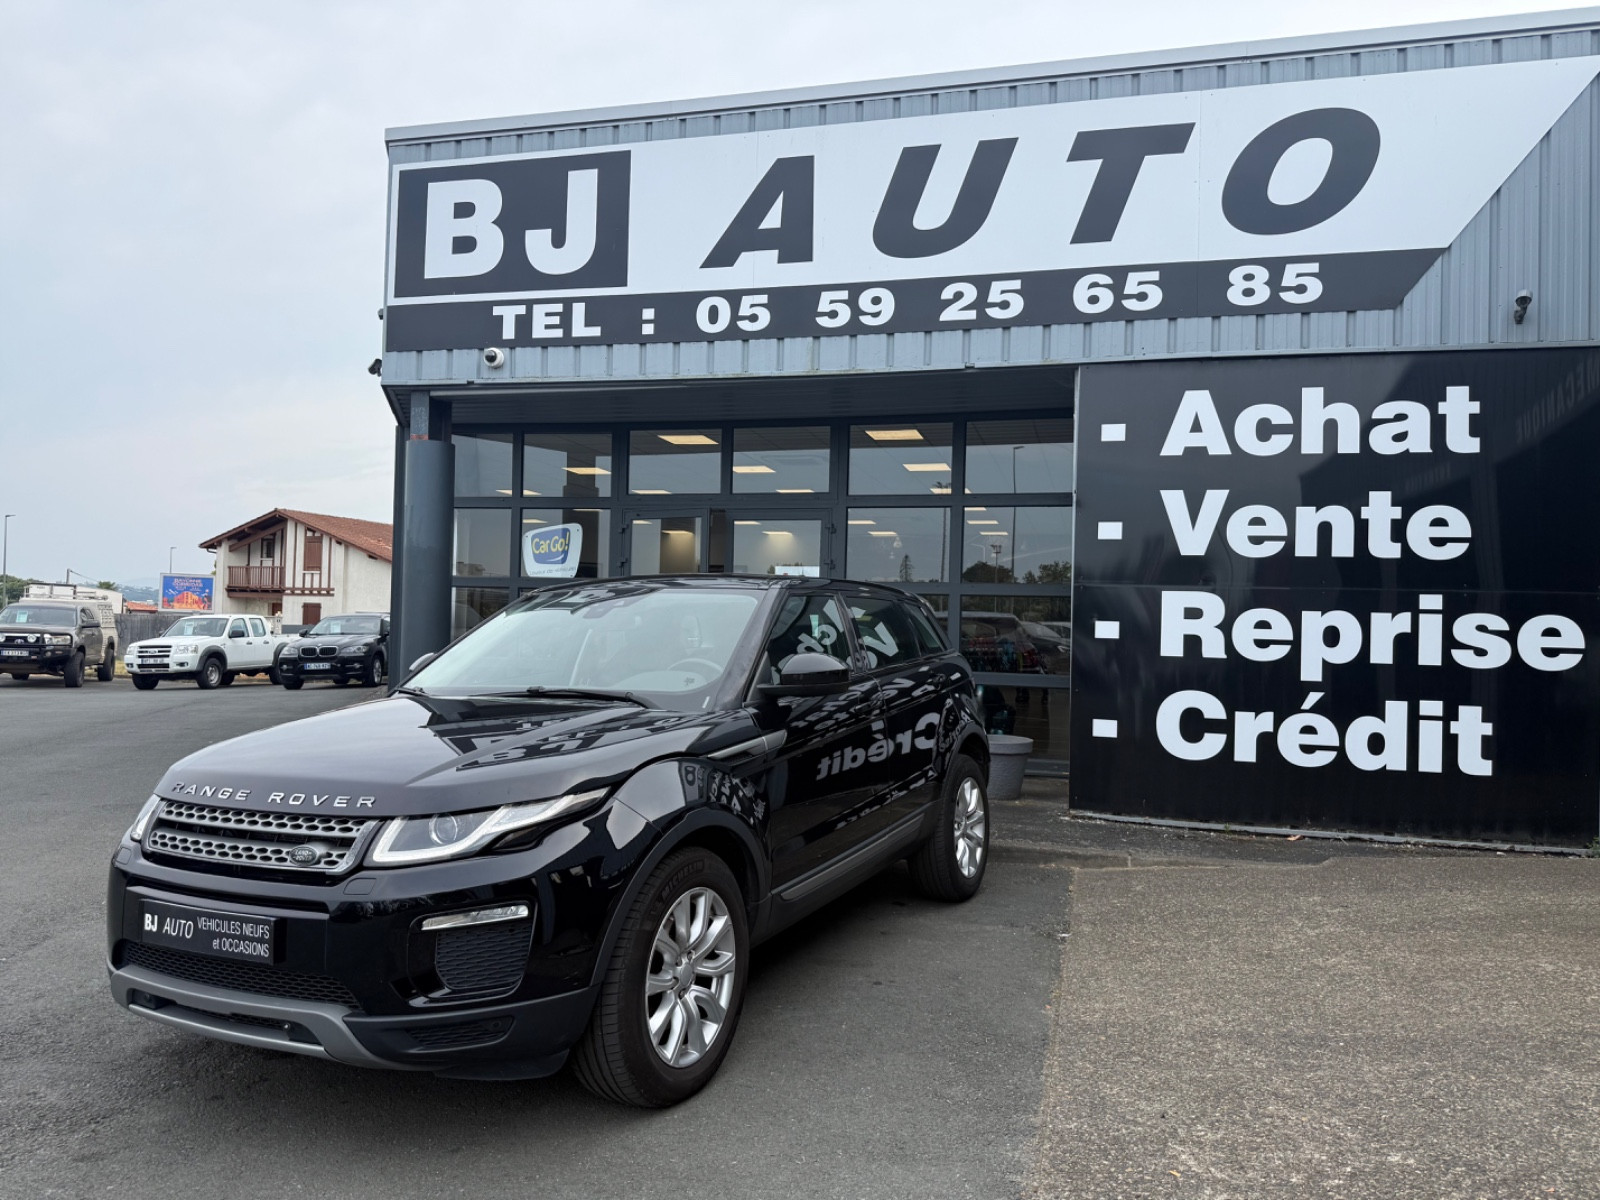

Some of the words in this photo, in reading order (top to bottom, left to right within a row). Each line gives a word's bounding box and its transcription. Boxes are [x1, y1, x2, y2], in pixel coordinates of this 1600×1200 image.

[424, 168, 598, 279] BJ
[700, 107, 1381, 268] AUTO
[492, 302, 601, 340] TEL
[696, 294, 771, 334] 05
[815, 287, 895, 328] 59
[939, 279, 1025, 322] 25
[1072, 270, 1163, 314] 65
[1226, 261, 1323, 306] 85
[1159, 385, 1481, 456] Achat
[1159, 489, 1472, 560] Vente
[1160, 590, 1586, 682] Reprise
[1155, 689, 1493, 776] Crédit
[171, 781, 251, 801] RANGE
[267, 792, 376, 808] ROVER
[144, 913, 158, 932] BJ
[162, 917, 194, 939] AUTO
[212, 938, 220, 950] et
[222, 938, 270, 957] OCCASIONS
[242, 923, 270, 940] NEUFS
